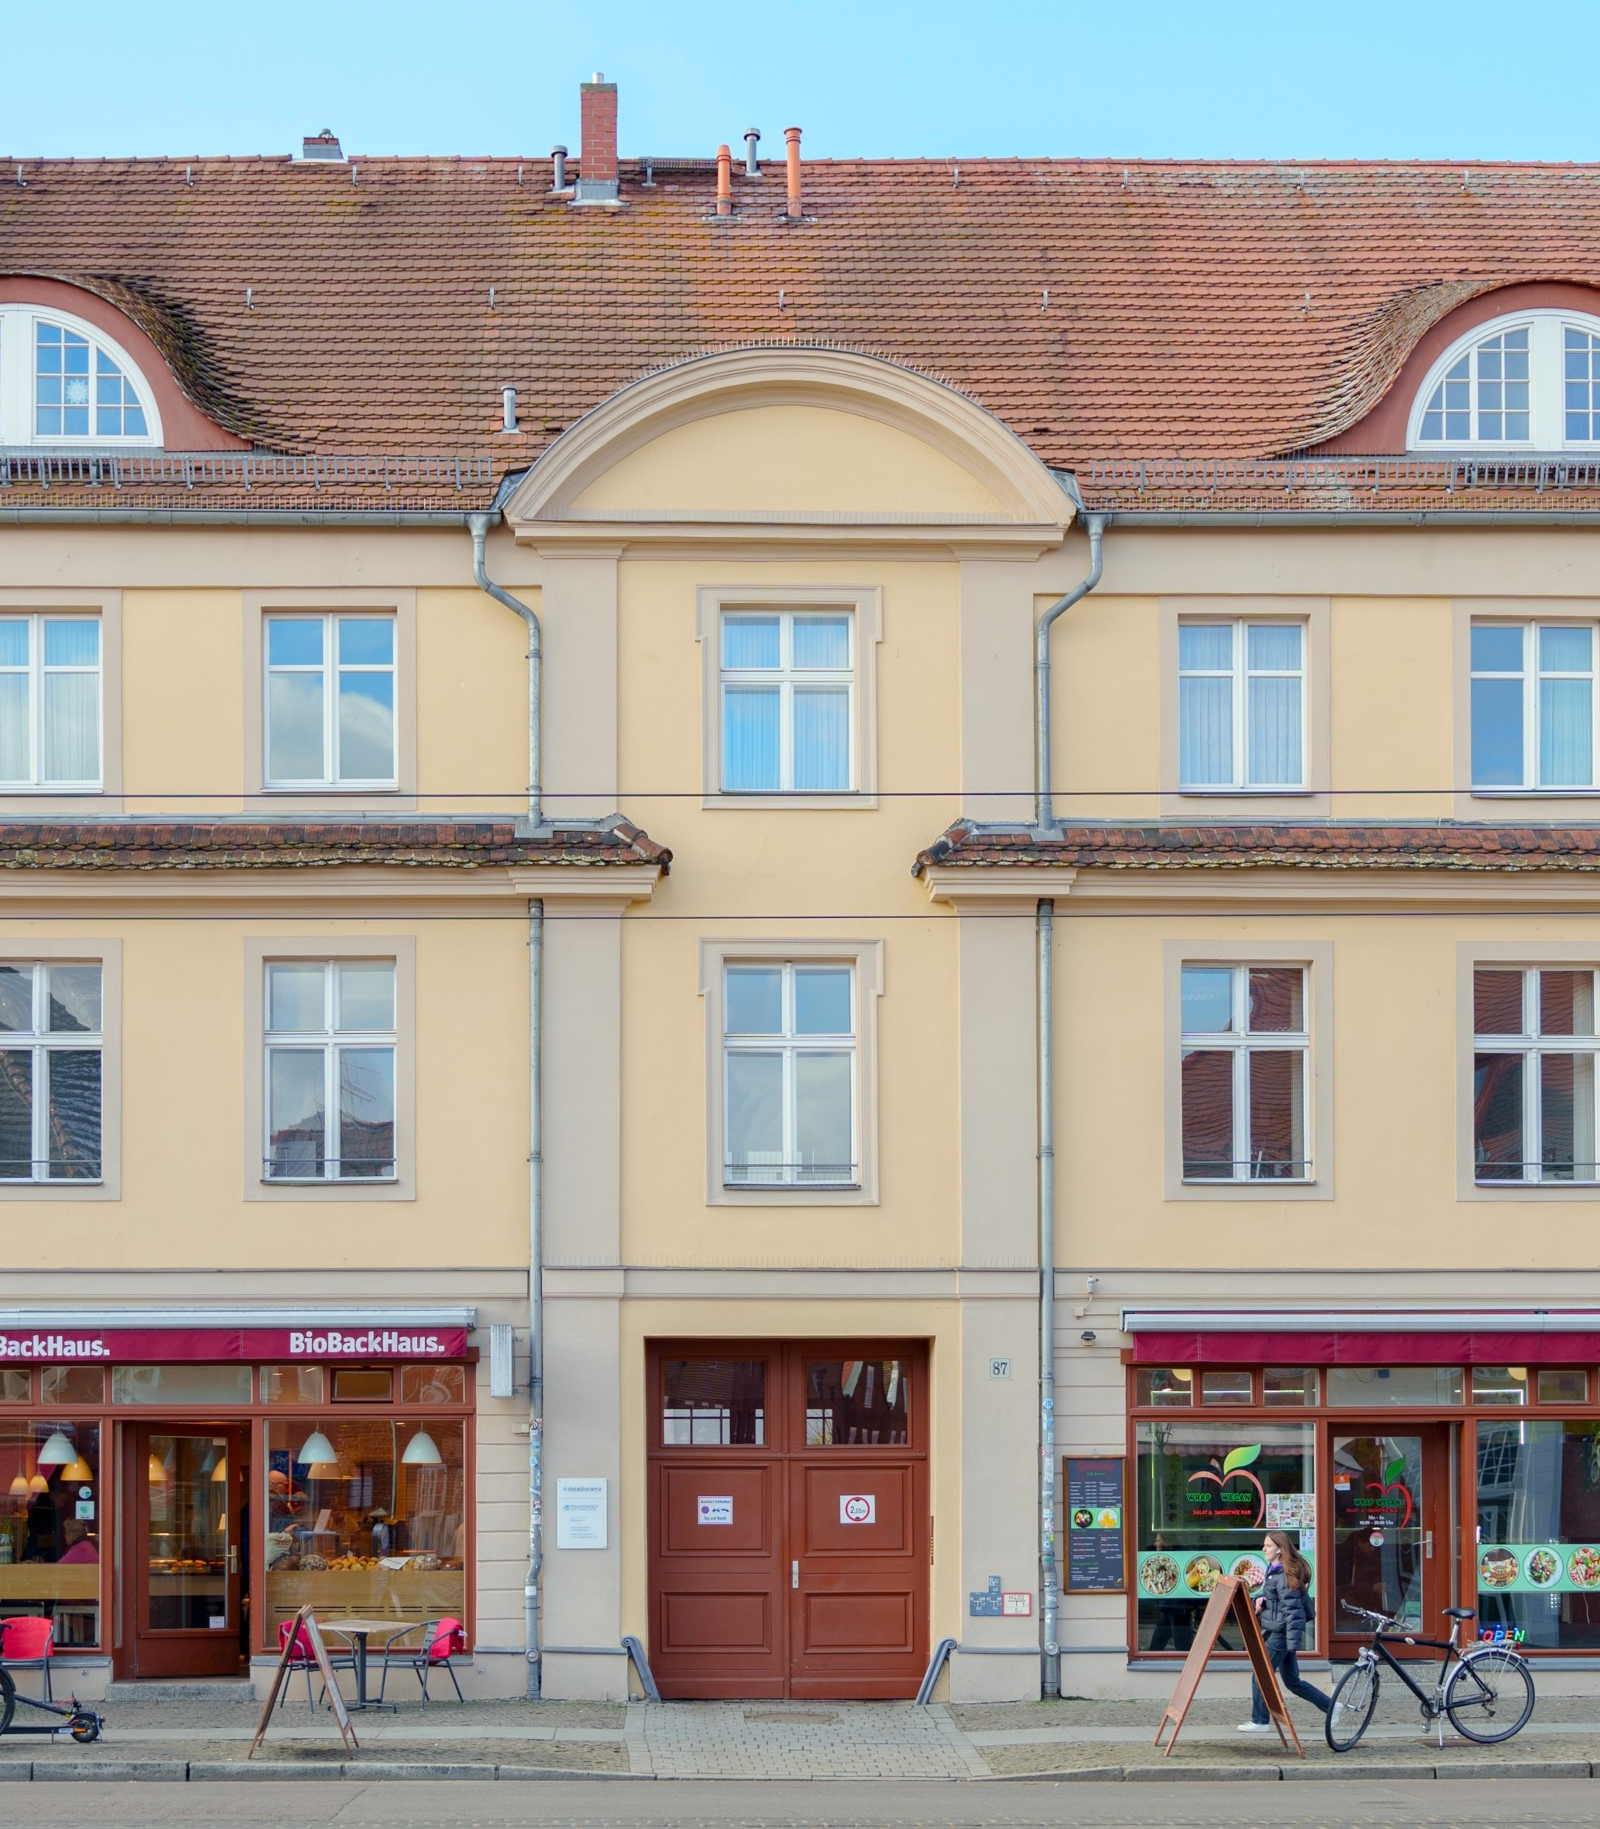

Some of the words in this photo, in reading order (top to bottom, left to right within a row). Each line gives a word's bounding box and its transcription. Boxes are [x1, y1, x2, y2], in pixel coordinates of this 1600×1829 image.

[290, 1331, 445, 1353] BioBackHaus.
[993, 1361, 1008, 1375] 87
[1186, 1492, 1211, 1502] WRAP
[1220, 1492, 1251, 1502] WEGAN
[1353, 1498, 1374, 1506] WRAP
[1483, 1630, 1525, 1642] OPEN
